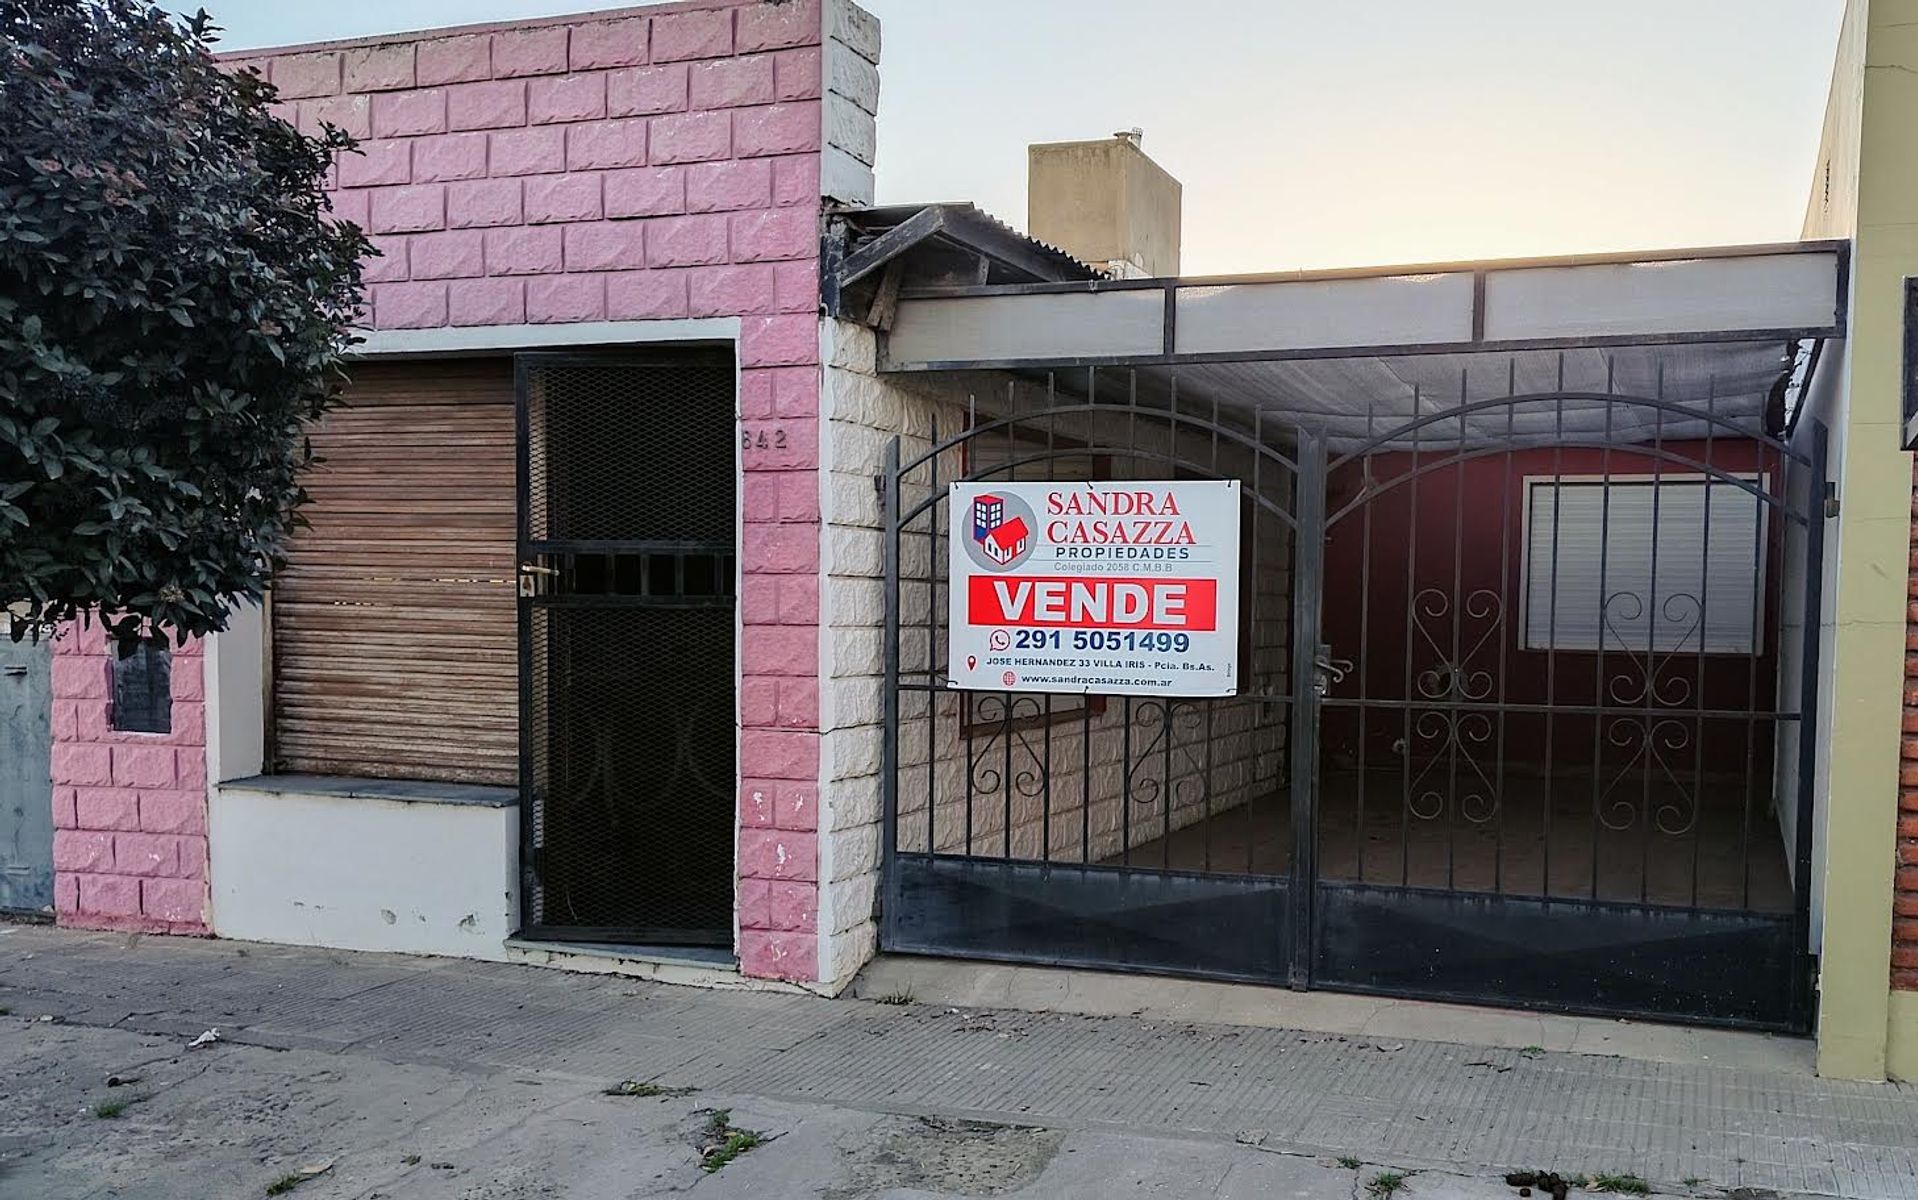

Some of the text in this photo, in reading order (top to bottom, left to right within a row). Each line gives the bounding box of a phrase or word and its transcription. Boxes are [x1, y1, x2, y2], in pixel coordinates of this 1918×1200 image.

[1047, 491, 1181, 516] SANDRA
[1047, 520, 1196, 545] CASAZZA
[1056, 547, 1189, 559] PROPIEDADES
[1054, 562, 1104, 573] Colegiado
[993, 580, 1188, 625] VENDE
[1015, 630, 1190, 653] 291 5051499
[986, 658, 1012, 666] JOSE
[1014, 658, 1076, 667] HERNANDEZ
[1078, 659, 1091, 667] 33
[1093, 660, 1122, 668] VILLA
[1125, 660, 1145, 669] IRIS
[1154, 661, 1179, 670] Pcia.
[1182, 662, 1215, 671] Bs.As.
[1021, 674, 1172, 687] www.sandracasazza.com.ar
